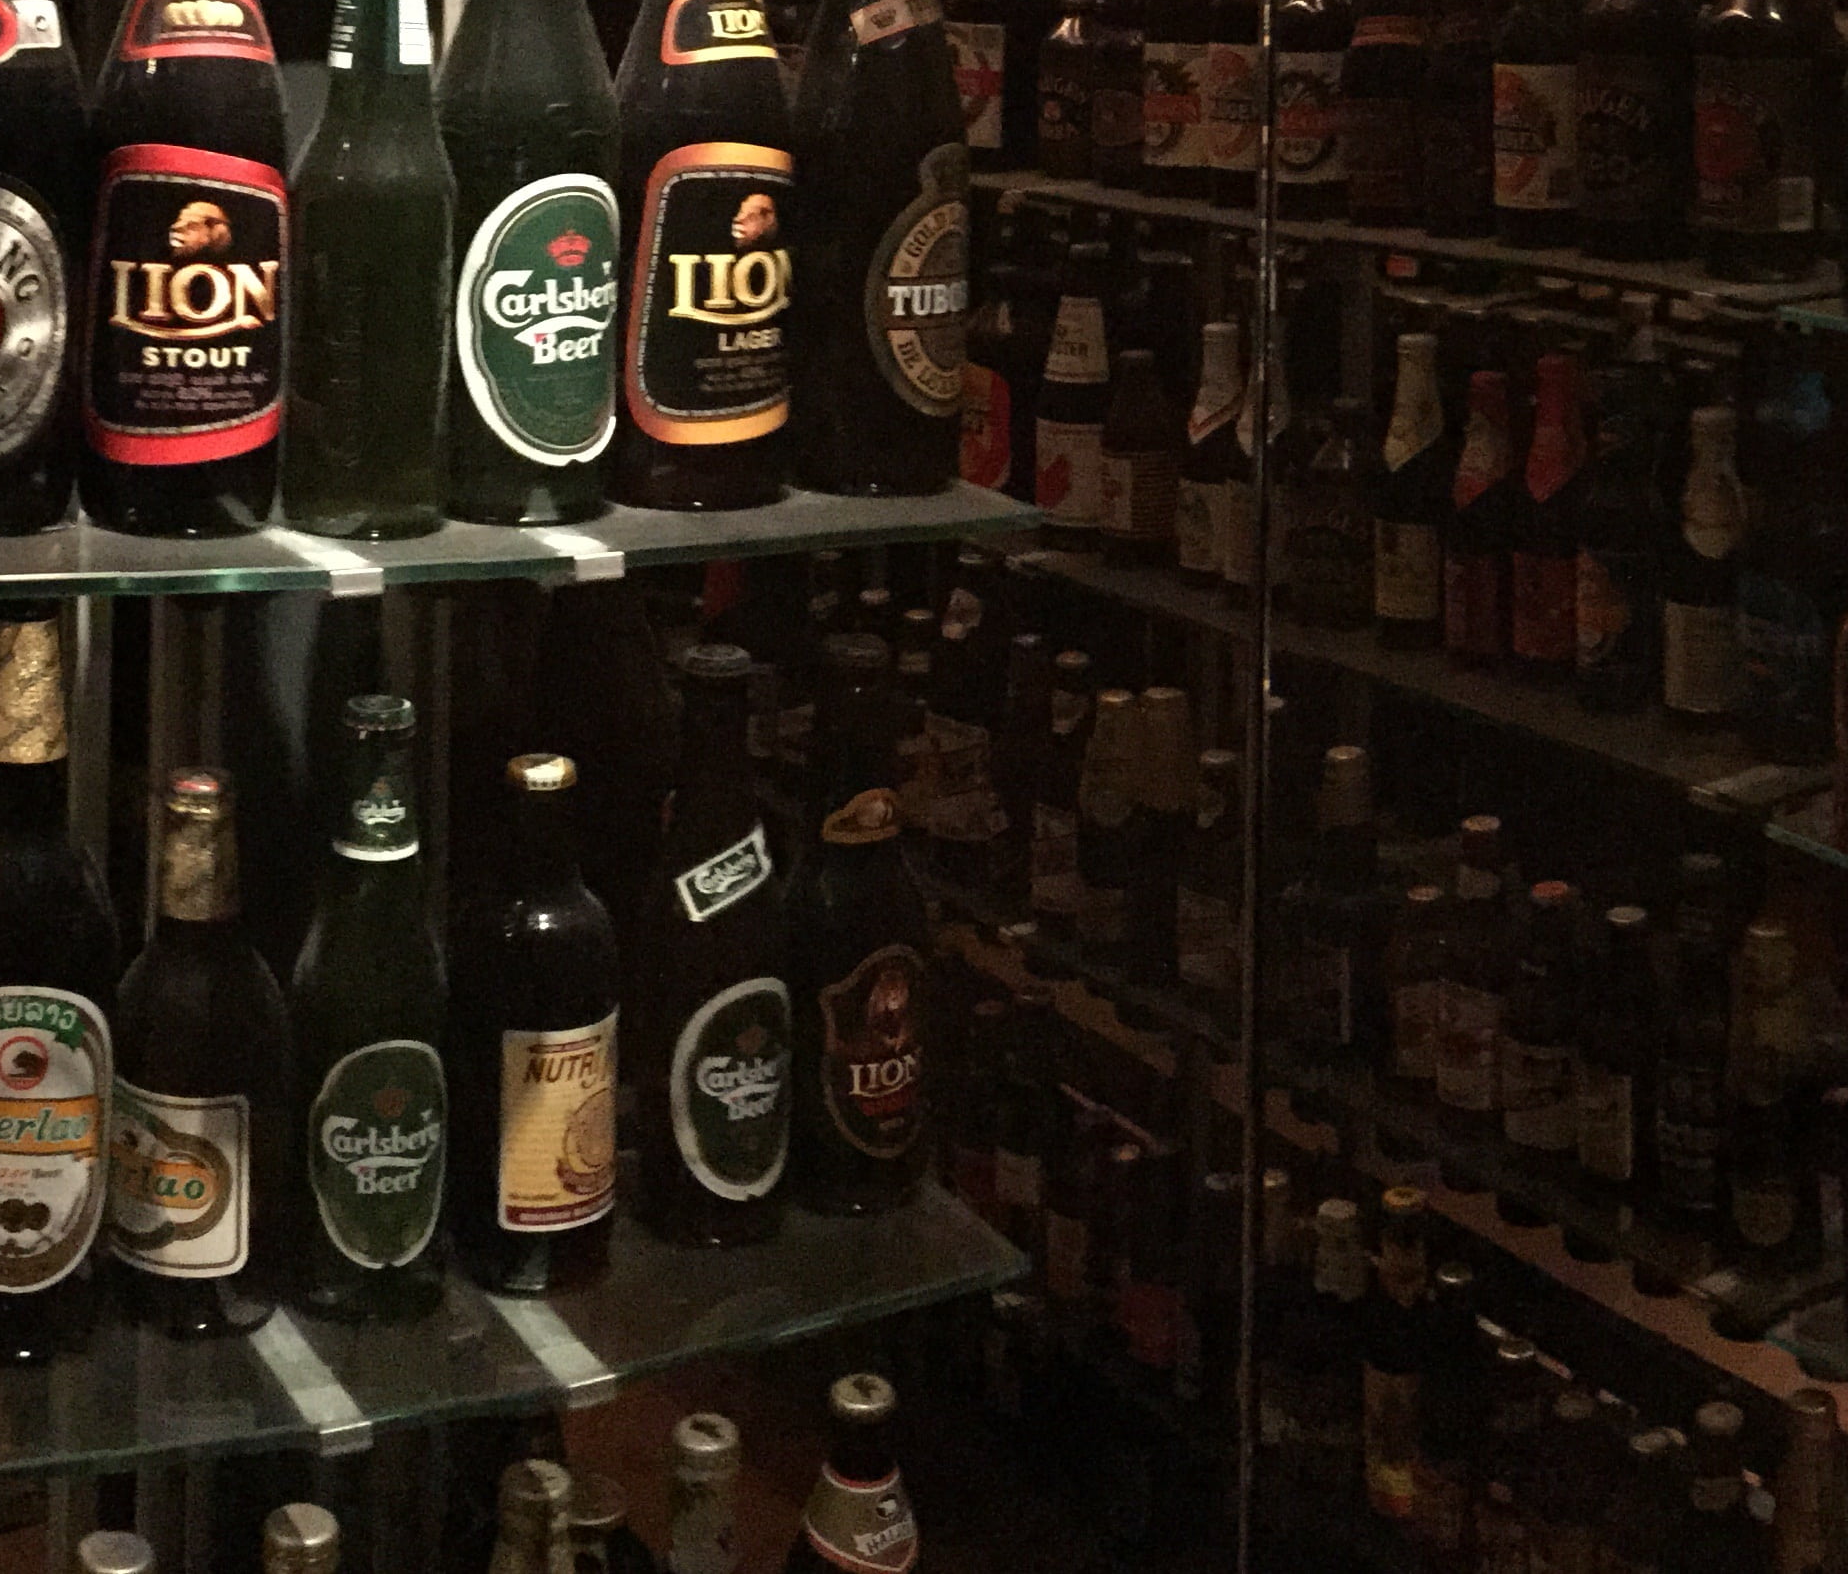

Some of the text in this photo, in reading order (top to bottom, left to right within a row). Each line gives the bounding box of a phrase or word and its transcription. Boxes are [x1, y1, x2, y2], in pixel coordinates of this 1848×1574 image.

[108, 259, 280, 336] LION
[140, 345, 254, 368] STOUT
[530, 330, 605, 366] Beer
